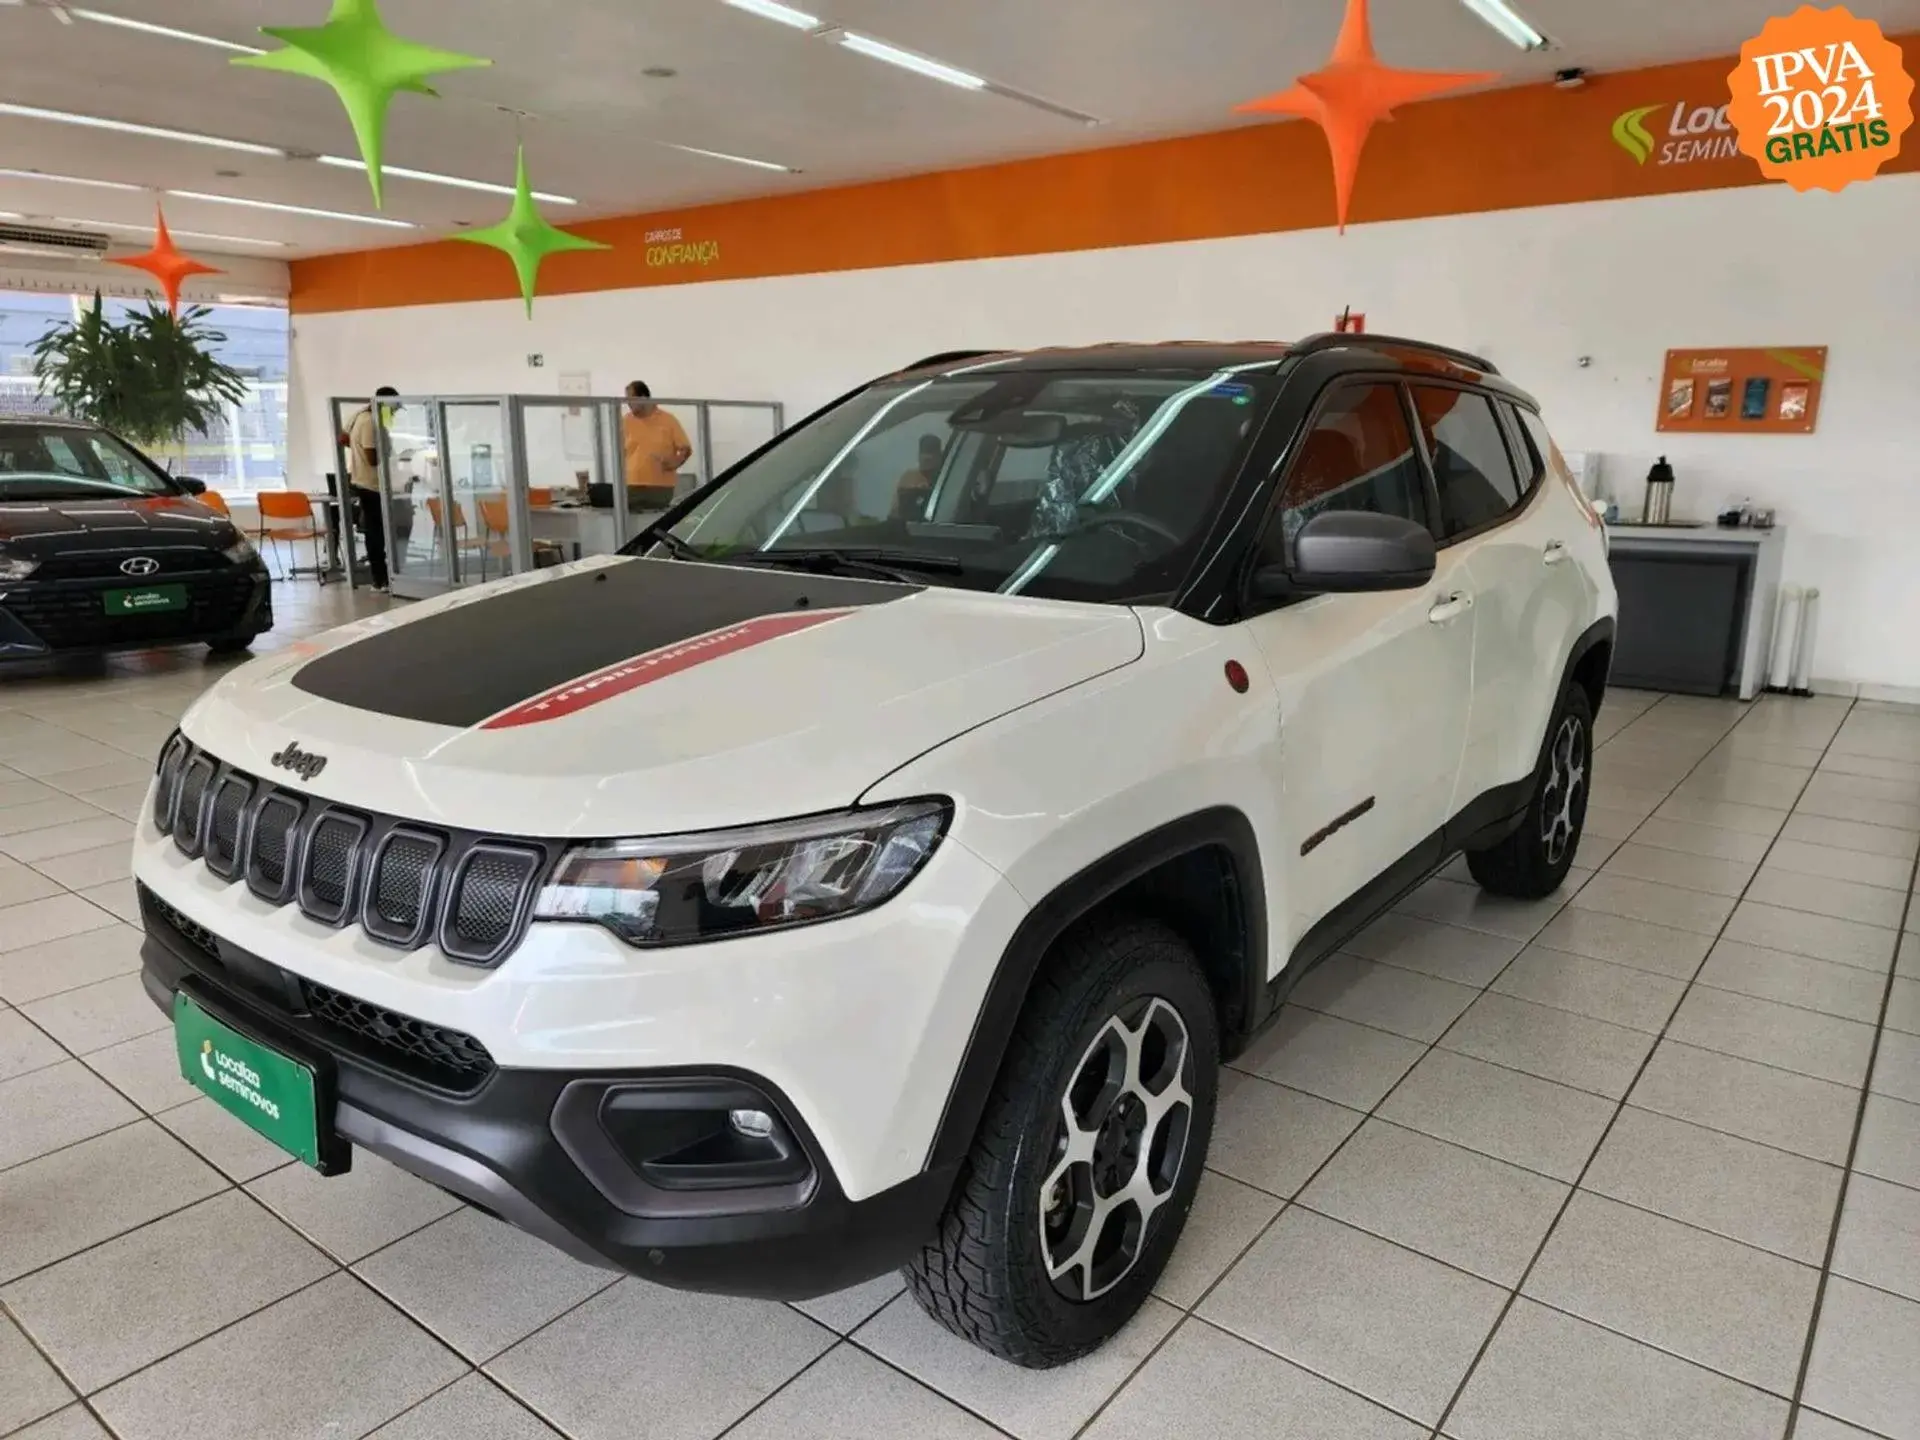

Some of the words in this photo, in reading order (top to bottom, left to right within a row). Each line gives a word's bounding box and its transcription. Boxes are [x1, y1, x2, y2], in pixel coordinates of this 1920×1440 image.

[1668, 101, 1732, 137] Loc
[1657, 136, 1738, 166] SEMIN
[646, 240, 719, 266] CONFIANÇA
[271, 741, 327, 781] Jeep
[215, 1049, 261, 1088] Localiza
[218, 1070, 280, 1120] seminovos
